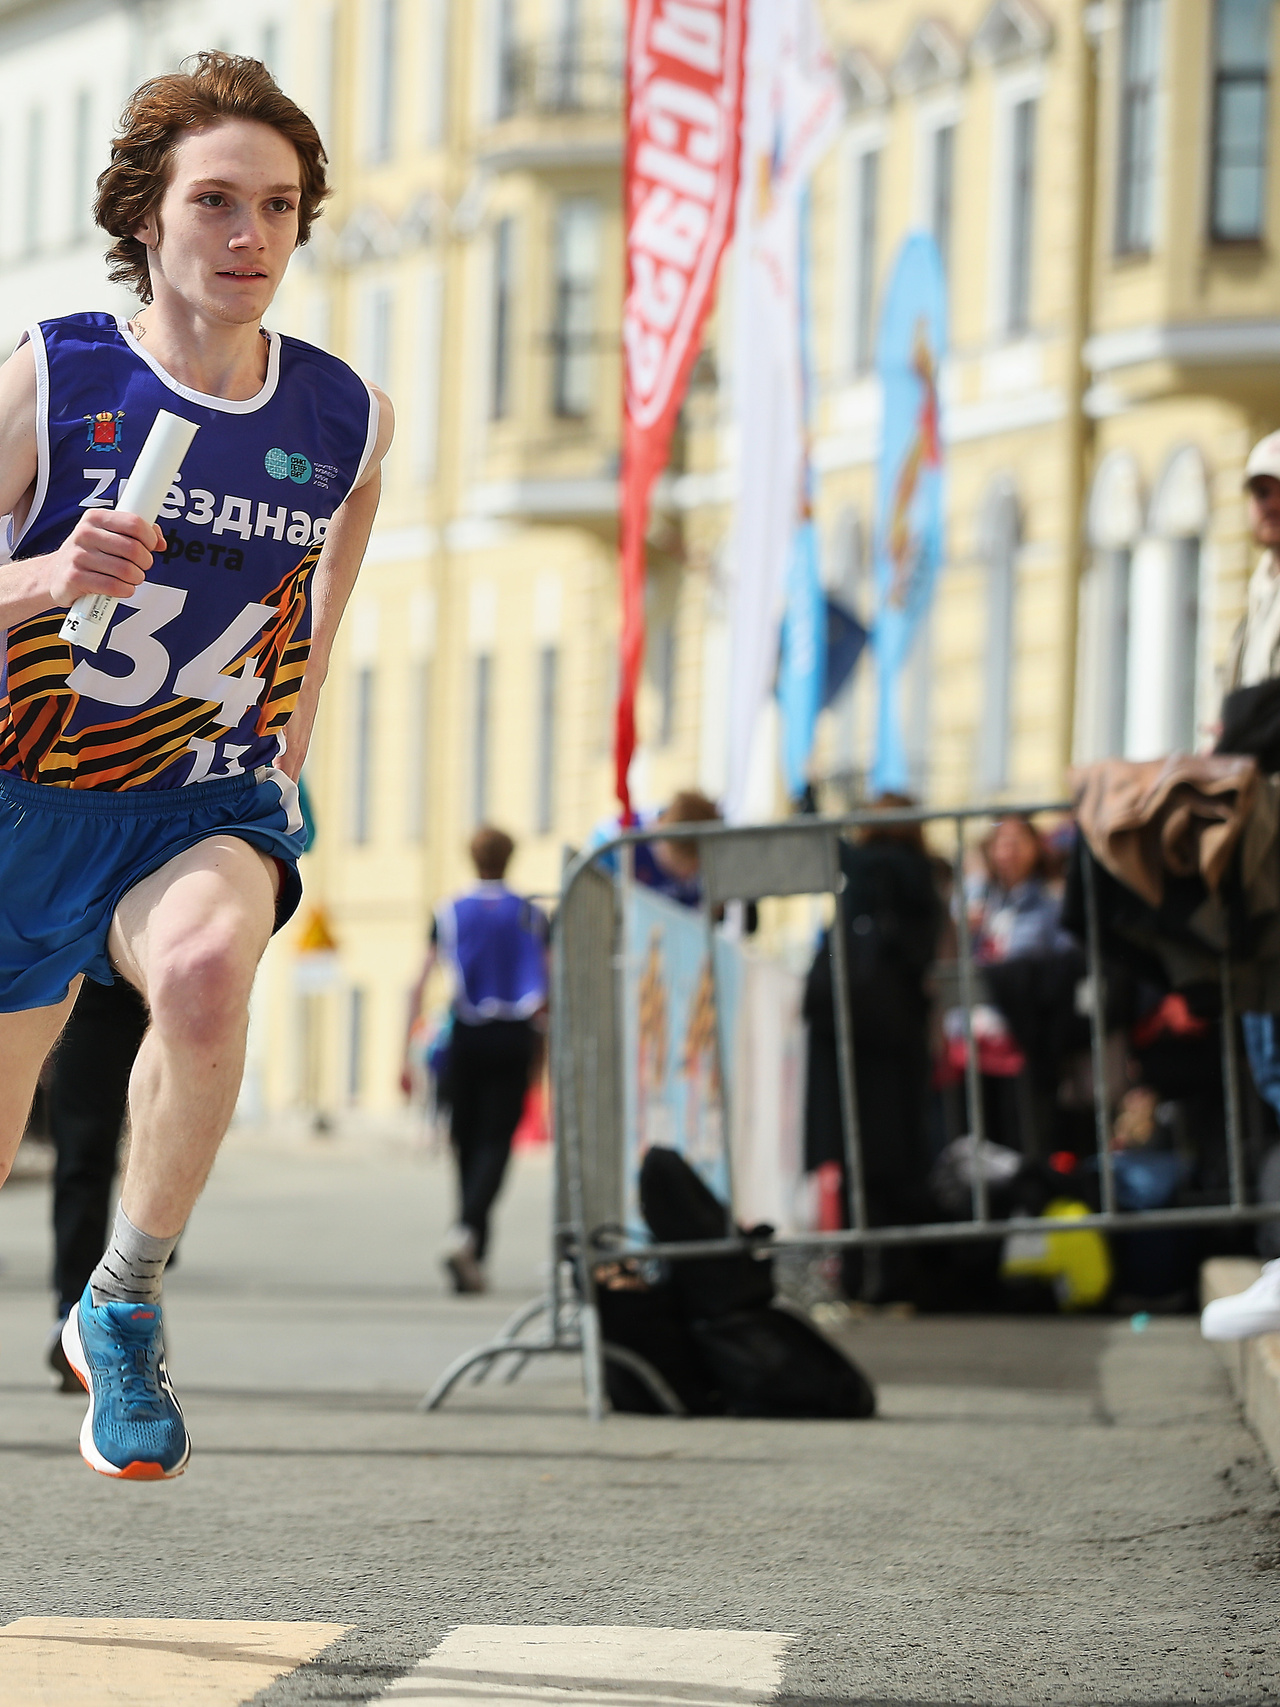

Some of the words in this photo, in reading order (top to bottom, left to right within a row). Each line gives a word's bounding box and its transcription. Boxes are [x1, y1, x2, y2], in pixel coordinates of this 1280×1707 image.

[78, 468, 330, 547] Zёздная
[163, 528, 244, 572] фета
[64, 581, 280, 728] 34
[181, 736, 253, 788] 13
